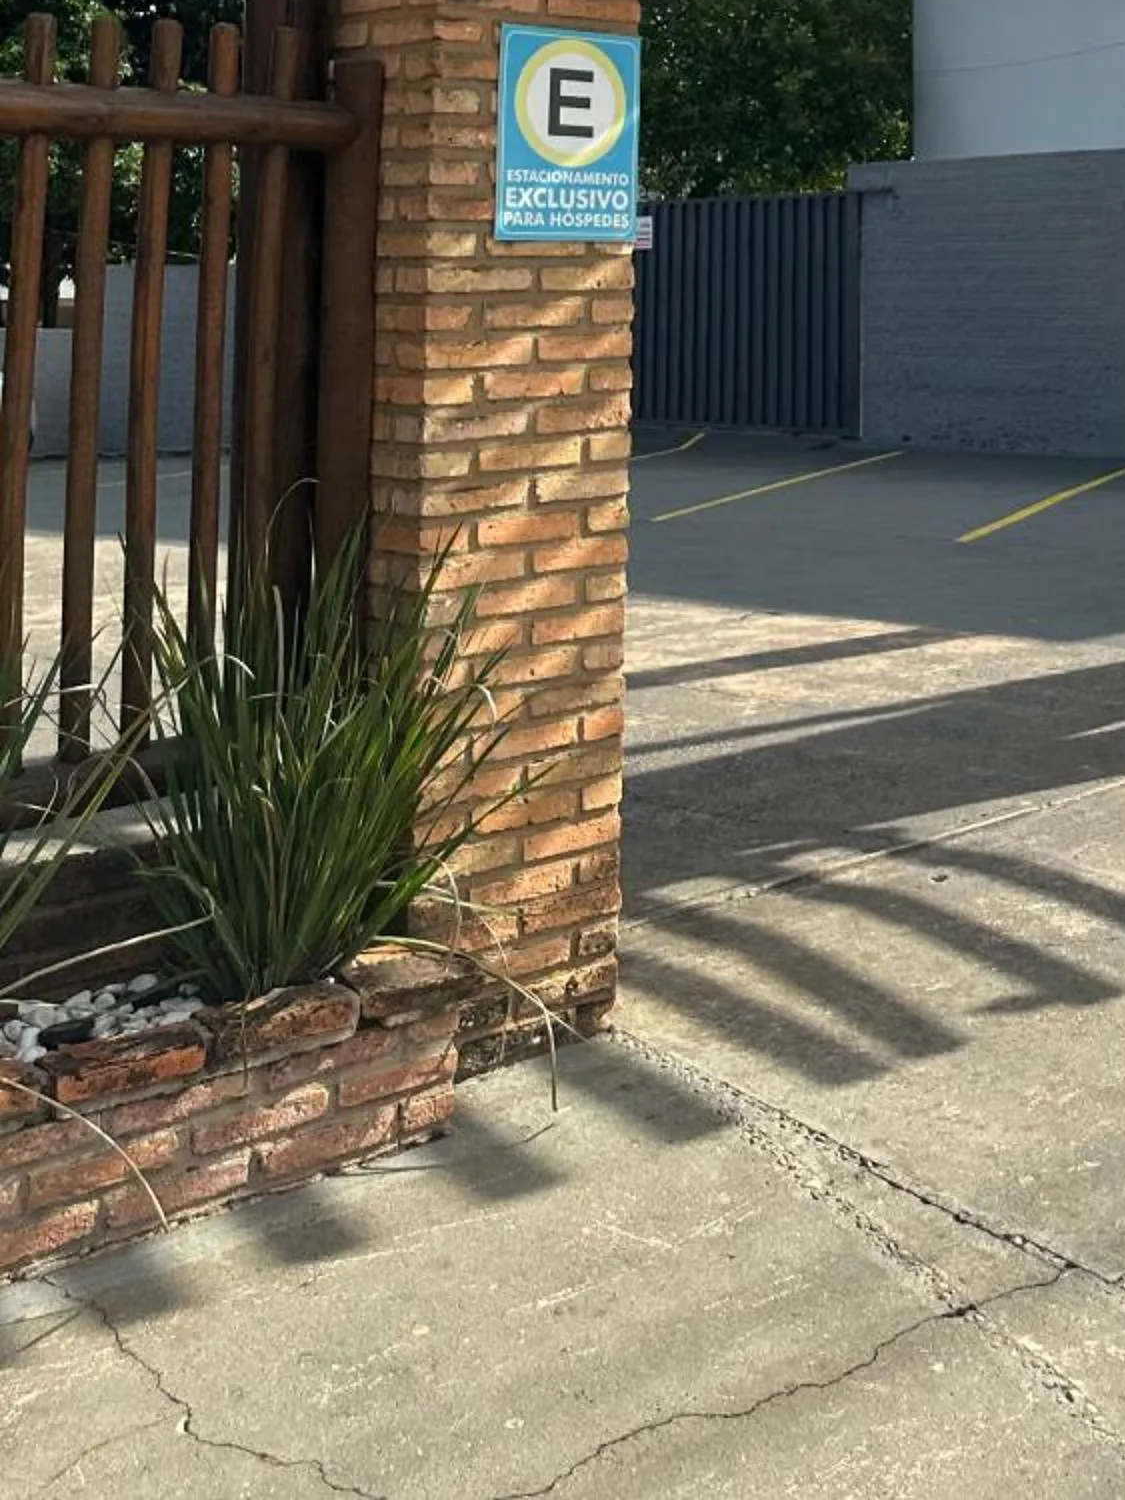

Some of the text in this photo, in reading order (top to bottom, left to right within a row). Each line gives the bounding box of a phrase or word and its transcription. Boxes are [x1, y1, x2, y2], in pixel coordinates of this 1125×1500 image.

[548, 67, 594, 138] E
[507, 169, 629, 186] ESTACIONAMENTO
[505, 187, 629, 211] EXCLUSIVO
[503, 208, 630, 229] PARA HÓSPEDES
